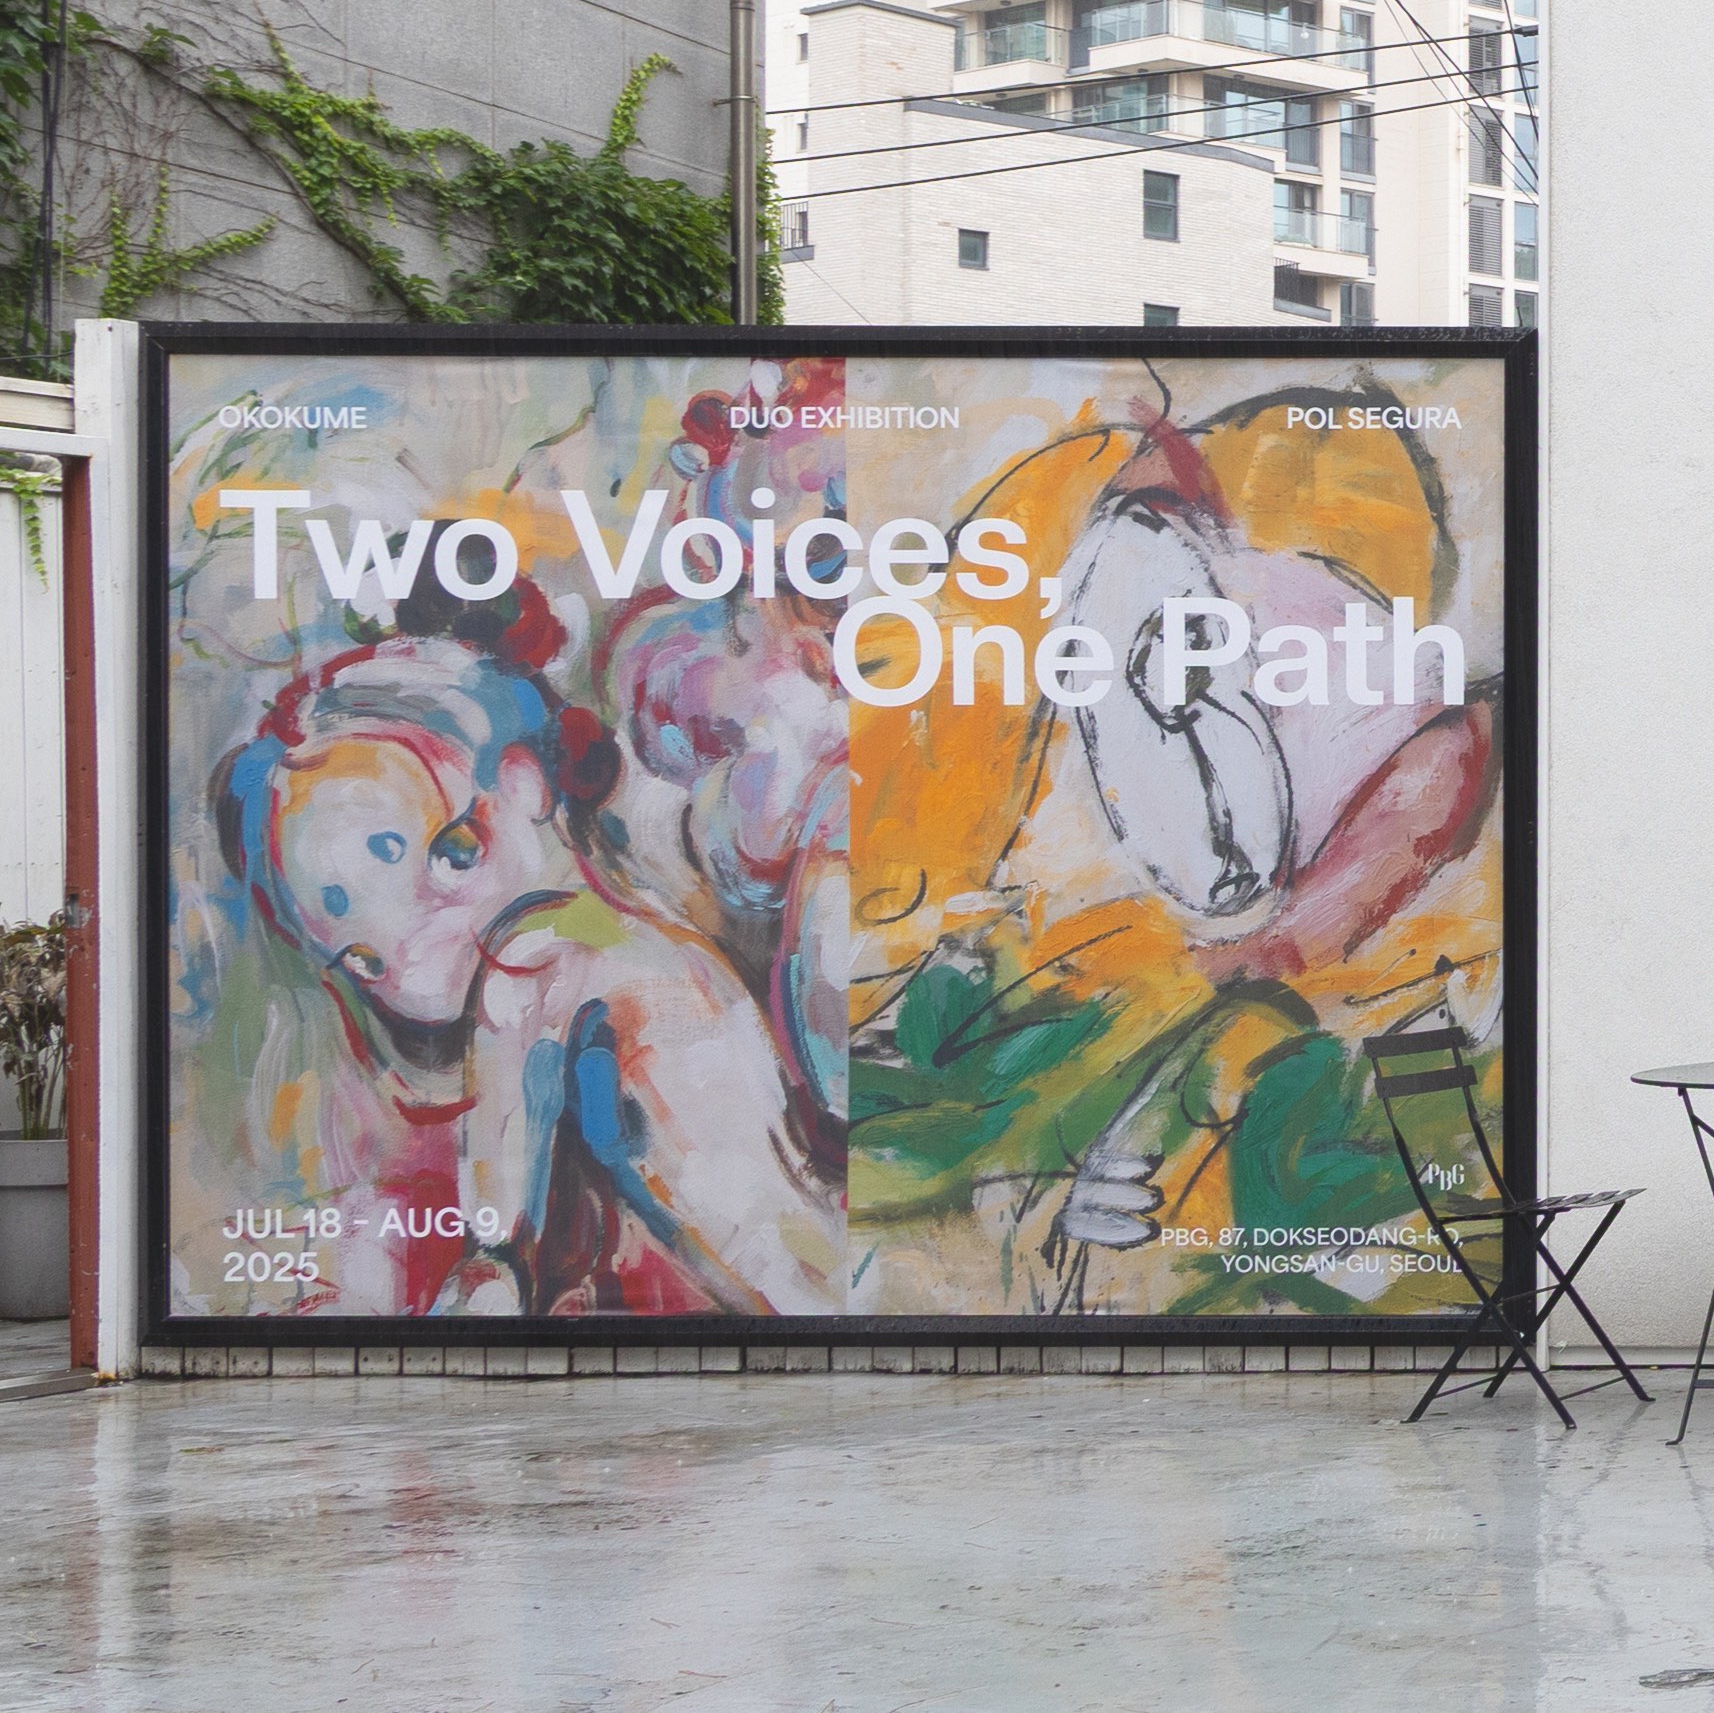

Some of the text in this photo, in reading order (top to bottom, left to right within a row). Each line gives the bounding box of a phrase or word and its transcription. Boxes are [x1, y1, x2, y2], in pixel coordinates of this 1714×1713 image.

[218, 405, 368, 430] OKOKUME
[730, 405, 960, 429] DUO EXHIBITION
[1286, 405, 1462, 431] POL SEGURA
[219, 487, 1063, 617] Two Voices,
[833, 595, 1467, 708] One Path
[1428, 1163, 1465, 1191] PBG
[223, 1207, 294, 1240] JUL
[303, 1207, 342, 1240] 18
[379, 1206, 465, 1238] AUG
[476, 1206, 508, 1241] 9,
[1161, 1228, 1213, 1249] PBG,
[1219, 1228, 1248, 1248] 87,
[223, 1251, 320, 1283] 2025
[1221, 1255, 1385, 1275] YONGSAN-GU,
